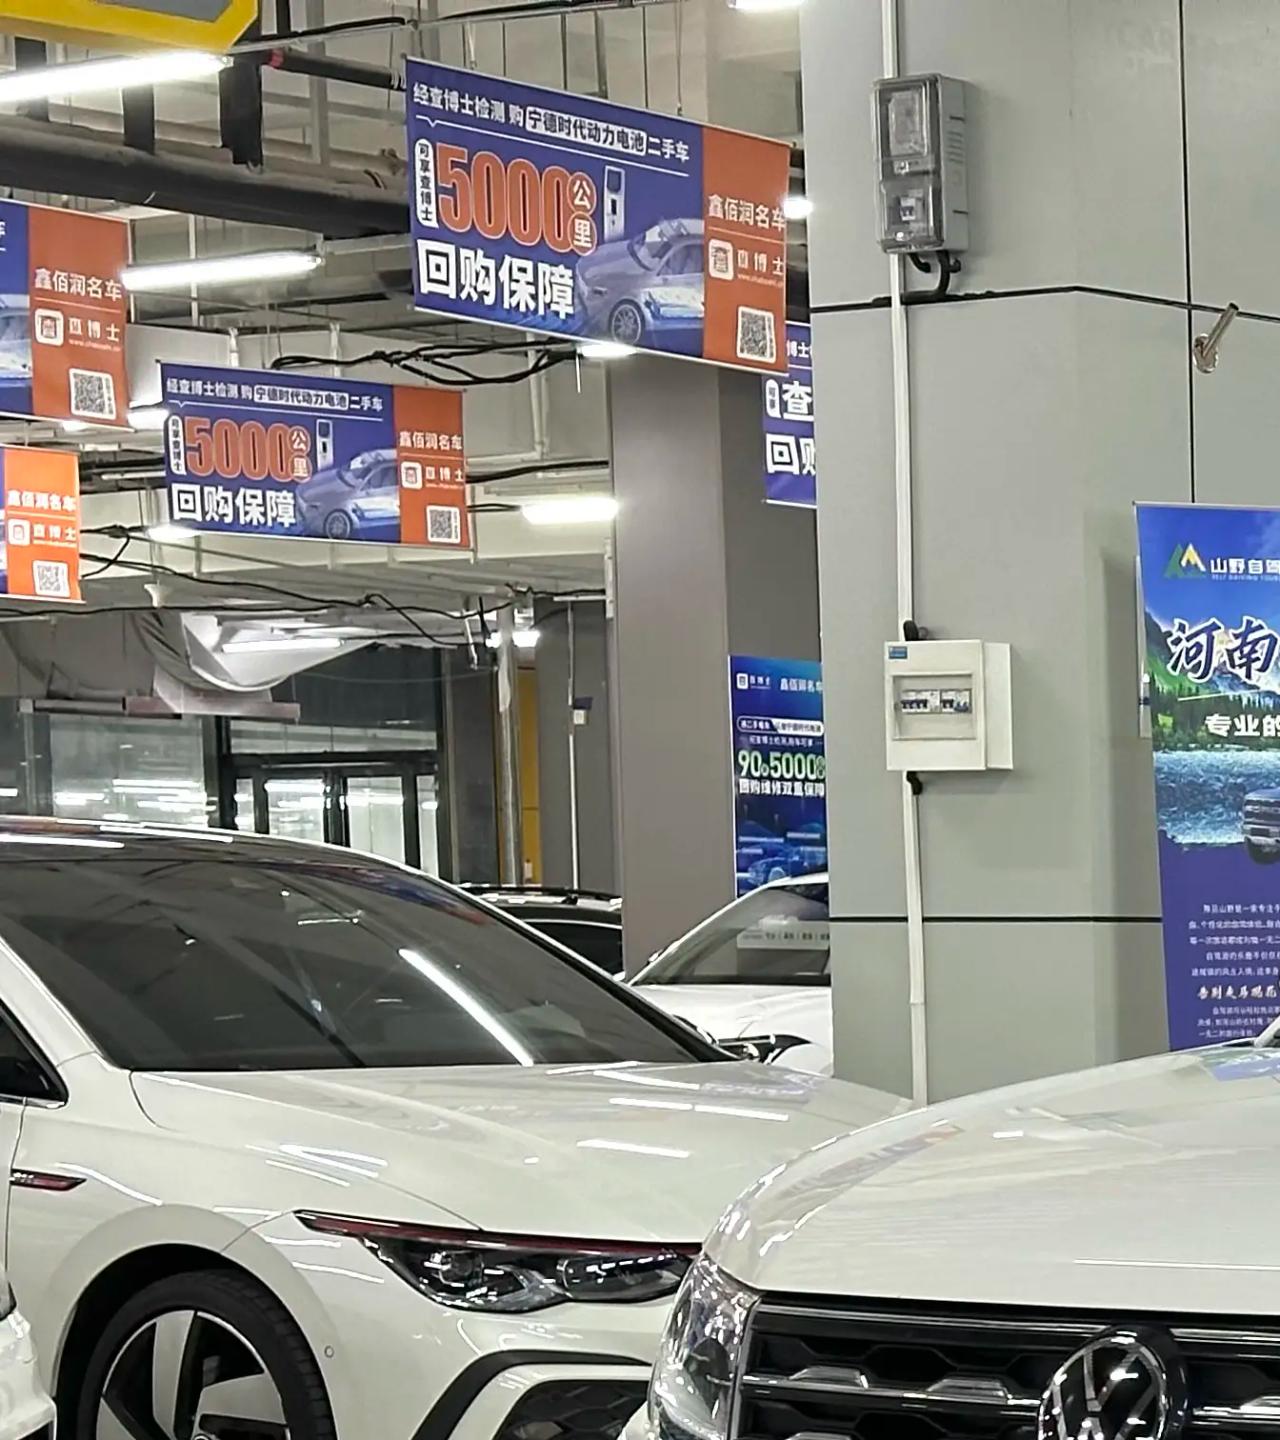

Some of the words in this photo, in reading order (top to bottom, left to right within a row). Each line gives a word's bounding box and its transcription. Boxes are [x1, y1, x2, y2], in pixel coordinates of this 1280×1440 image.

[34, 267, 123, 302] 鑫佰润名车
[417, 238, 575, 320] 回购保障
[171, 483, 297, 528] 回购保障
